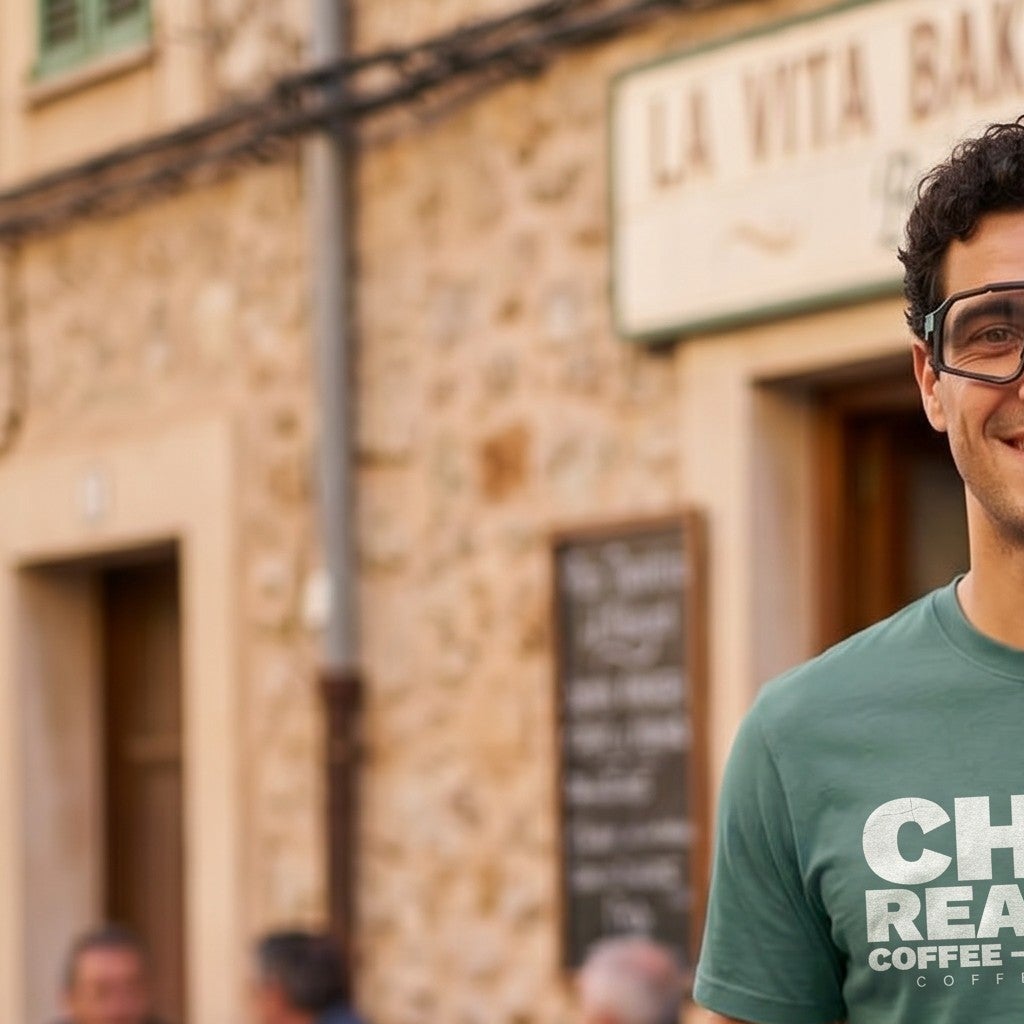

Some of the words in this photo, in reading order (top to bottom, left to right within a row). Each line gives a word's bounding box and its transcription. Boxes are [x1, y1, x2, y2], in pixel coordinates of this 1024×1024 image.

[649, 84, 716, 188] LA
[740, 40, 872, 160] VITA
[868, 944, 1003, 971] COFFEE
